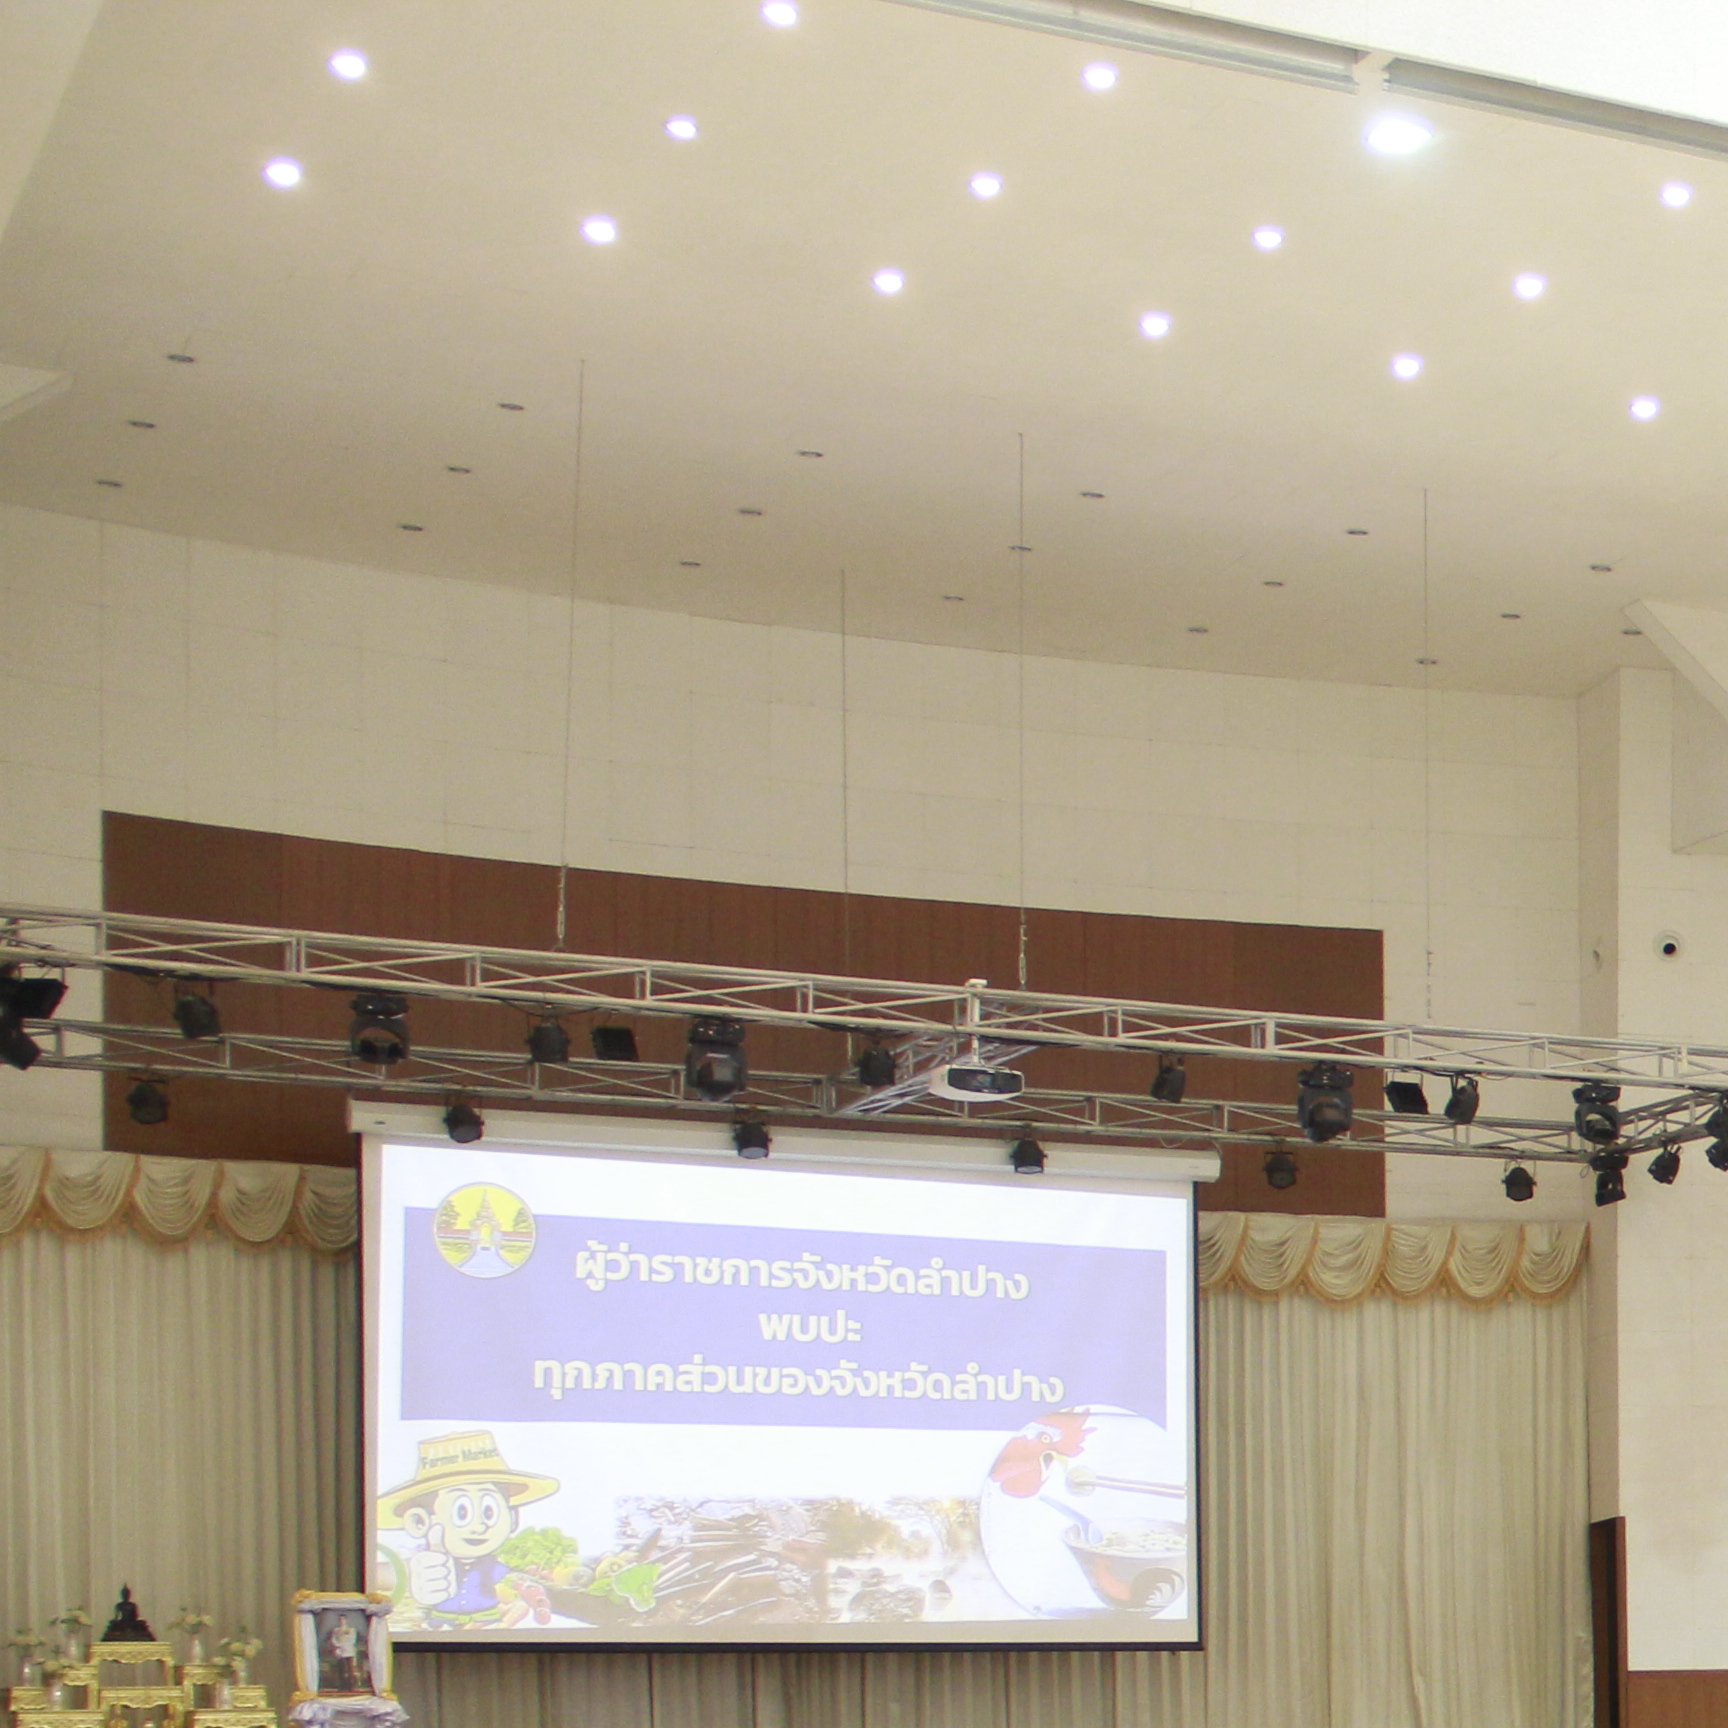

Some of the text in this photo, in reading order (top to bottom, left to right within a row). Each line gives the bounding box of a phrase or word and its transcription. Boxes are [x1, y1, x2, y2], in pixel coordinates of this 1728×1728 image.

[575, 1239, 1030, 1300] ผู้ว่าราชการจังหวัดลำปาง
[758, 1309, 862, 1342] พบปะ
[533, 1354, 1064, 1404] ทุกภาคส่วนของจังหวัดลำปาง
